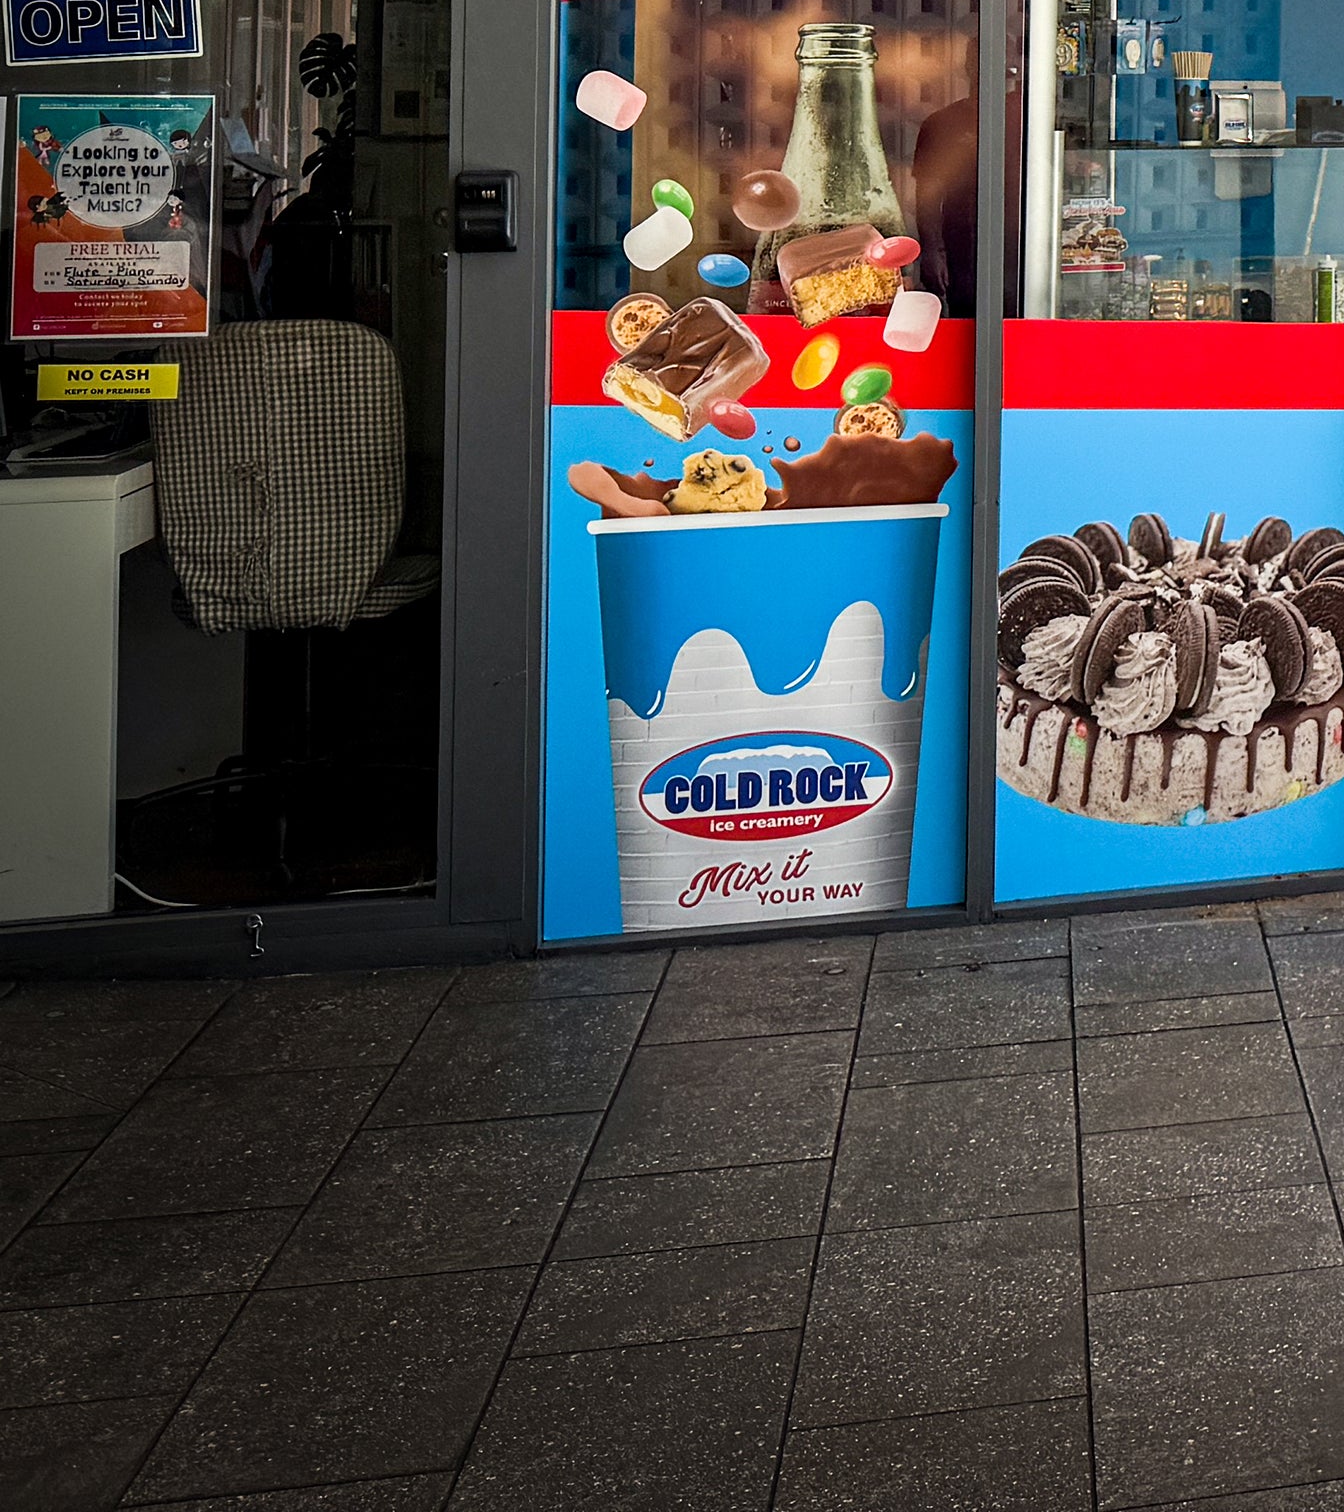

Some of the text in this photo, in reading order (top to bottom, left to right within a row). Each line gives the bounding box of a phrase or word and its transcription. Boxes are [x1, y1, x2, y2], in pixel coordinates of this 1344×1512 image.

[72, 145, 159, 162] Looking to
[62, 163, 170, 179] Explore your
[78, 181, 131, 195] Talent
[87, 198, 143, 213] Music?
[70, 243, 160, 256] FREE TRIAL
[64, 266, 100, 277] Flute
[117, 266, 155, 277] Piano
[138, 276, 187, 288] Sunday
[67, 369, 150, 381] NO CASH
[664, 761, 870, 814] COLD ROCK
[710, 813, 824, 833] ice creamery
[678, 848, 813, 908] Mix it
[757, 882, 863, 905] YOUR WAY
